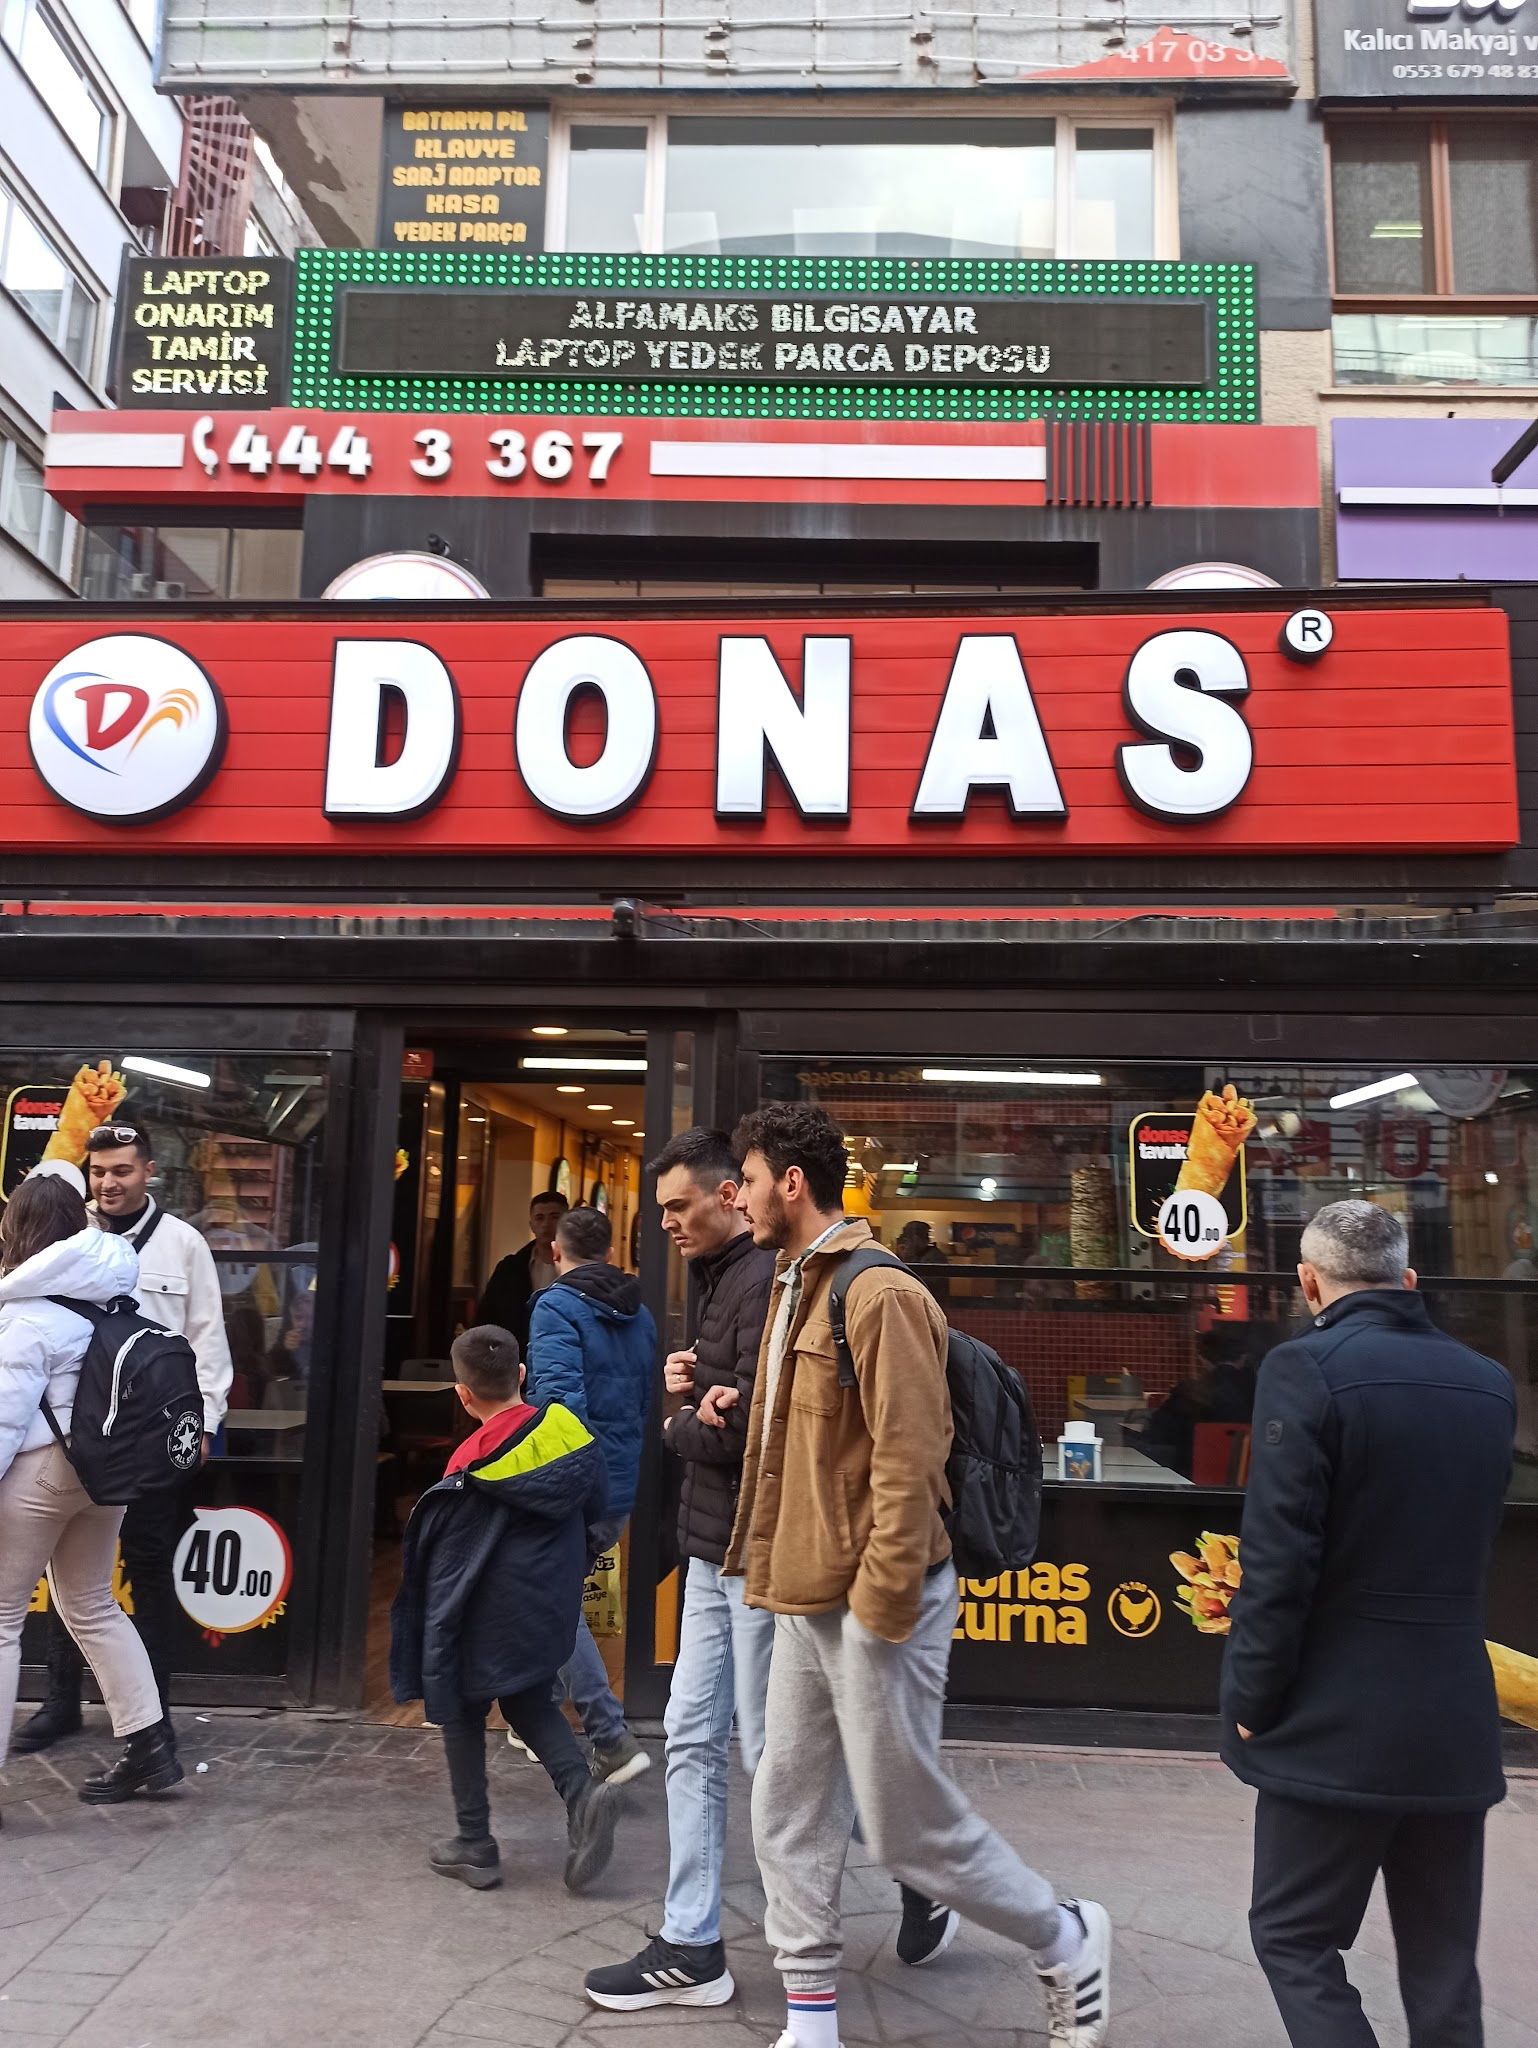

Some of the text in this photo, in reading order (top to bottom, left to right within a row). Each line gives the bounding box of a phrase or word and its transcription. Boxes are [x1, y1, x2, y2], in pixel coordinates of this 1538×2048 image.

[1187, 41, 1227, 63] 03
[1419, 27, 1519, 57] Makyaj
[1392, 64, 1443, 79] 0553
[1446, 64, 1485, 78] 679
[402, 111, 494, 131] BATARYA
[414, 138, 516, 159] KLAVYE
[448, 166, 541, 186] ADAPTOR
[426, 194, 500, 214] KASA
[394, 221, 527, 245] YEDEK PARÇA
[143, 270, 270, 295] LAPTOP
[134, 303, 274, 328] ONARIM
[568, 301, 760, 331] ALFAMAKS
[146, 330, 257, 361] TAMİR
[495, 338, 636, 368] LAPTOP
[644, 340, 765, 371] YEDEK
[904, 344, 1051, 373] DEPOSU
[131, 363, 269, 395] SERVİSİ
[227, 424, 623, 480] 444 3 367
[323, 628, 1256, 819] DONAS
[1138, 1126, 1189, 1143] donas
[1138, 1143, 1189, 1160] tavuk
[181, 1529, 273, 1597] 40.00
